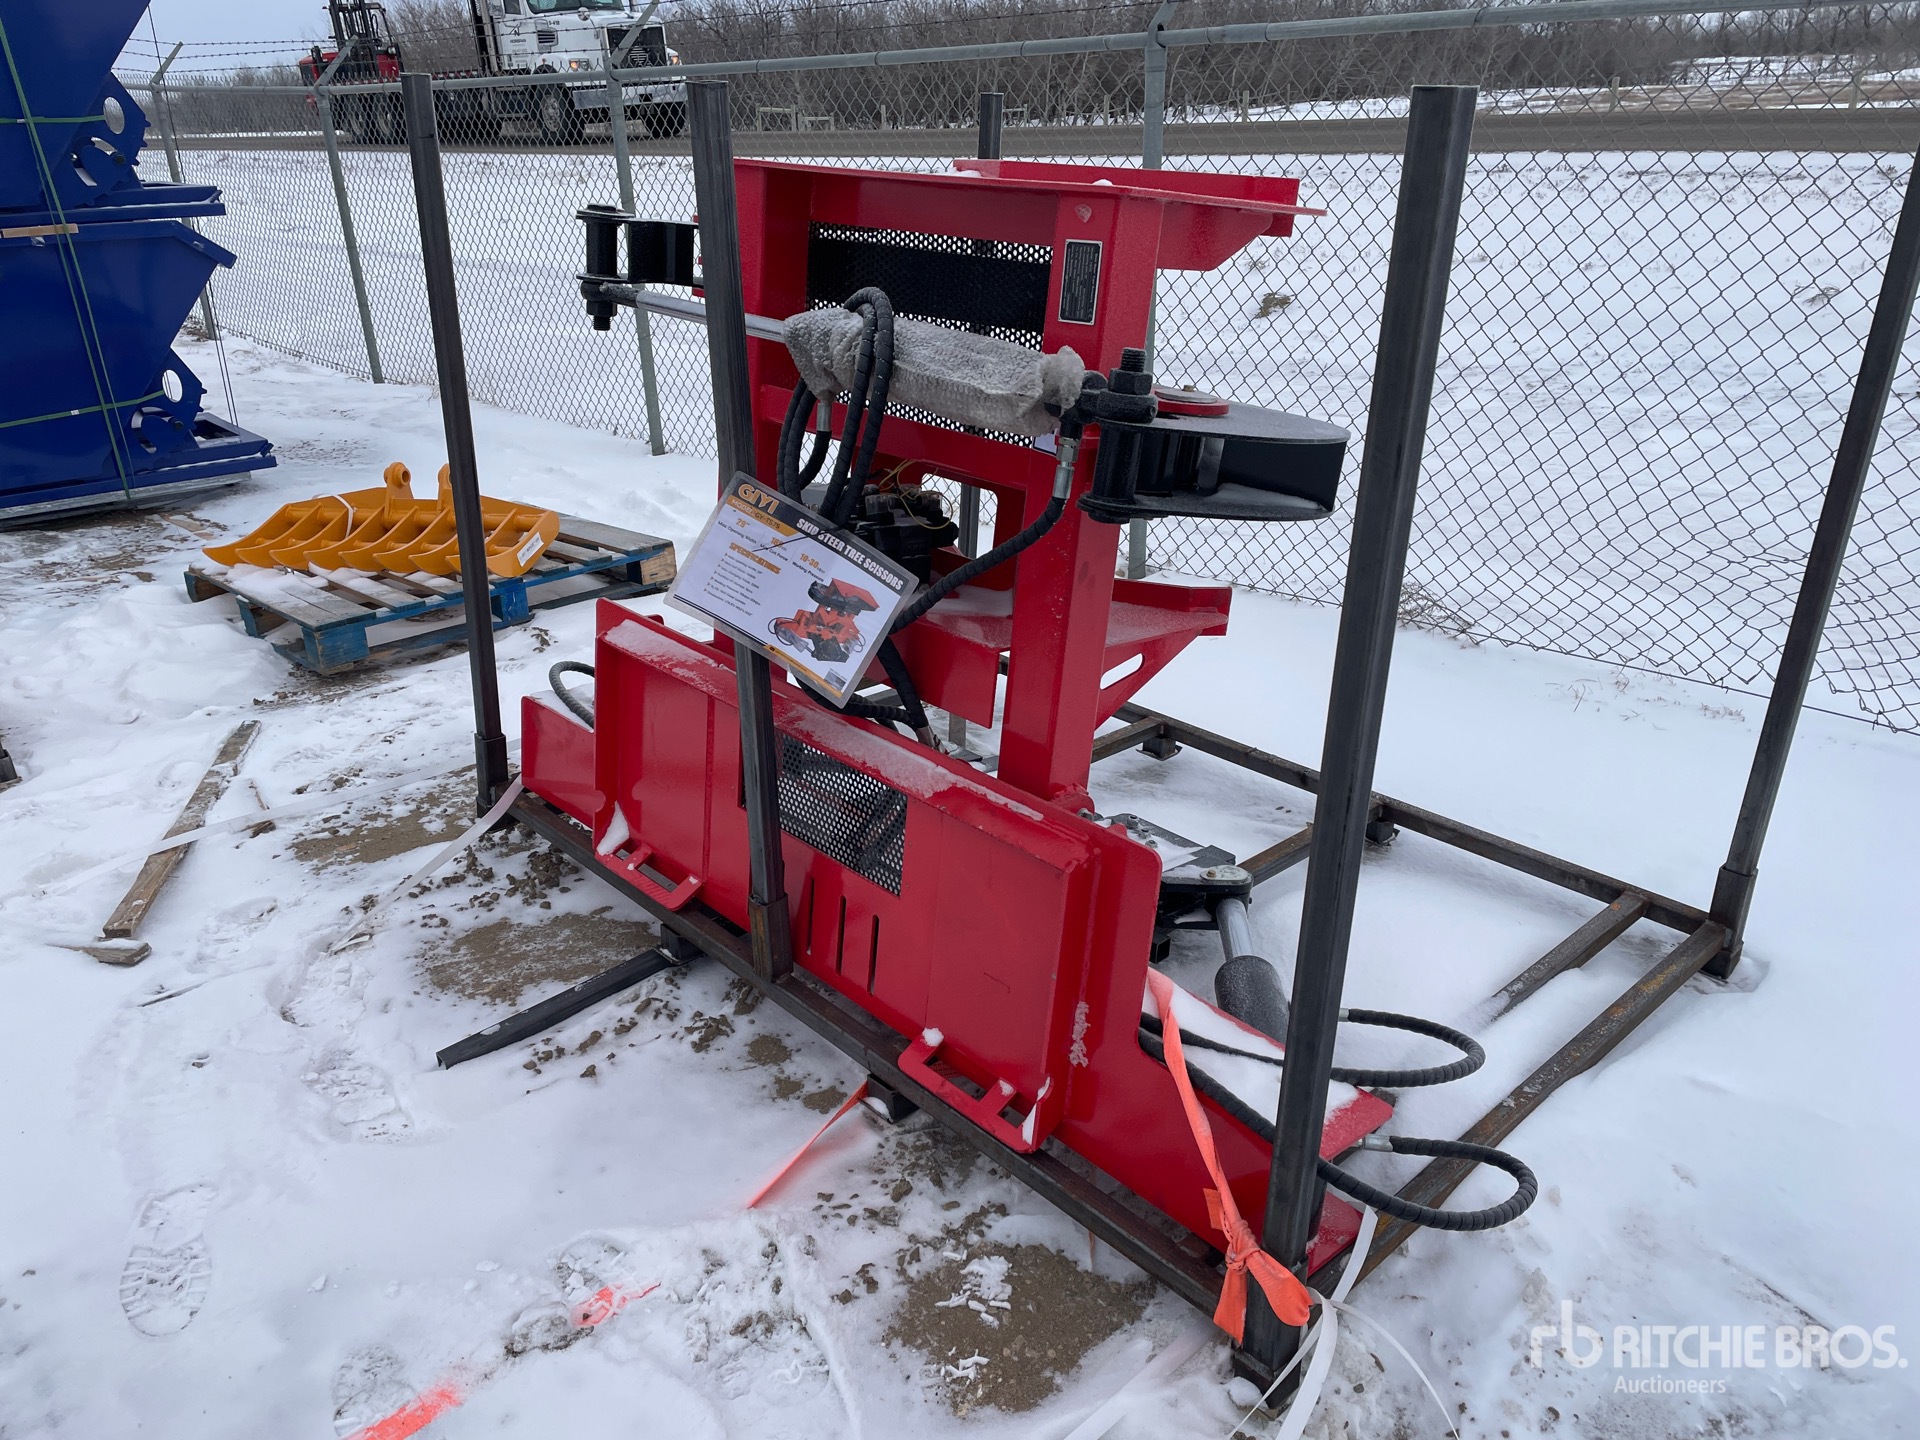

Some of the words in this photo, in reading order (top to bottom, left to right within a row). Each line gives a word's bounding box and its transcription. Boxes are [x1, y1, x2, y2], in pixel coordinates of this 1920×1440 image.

[738, 483, 780, 514] GIYI
[796, 518, 820, 536] SKID
[817, 530, 845, 552] STEER
[843, 544, 866, 565] TREE
[863, 558, 904, 591] SCISSORS
[792, 561, 809, 574] Working
[807, 570, 824, 582] Pressure
